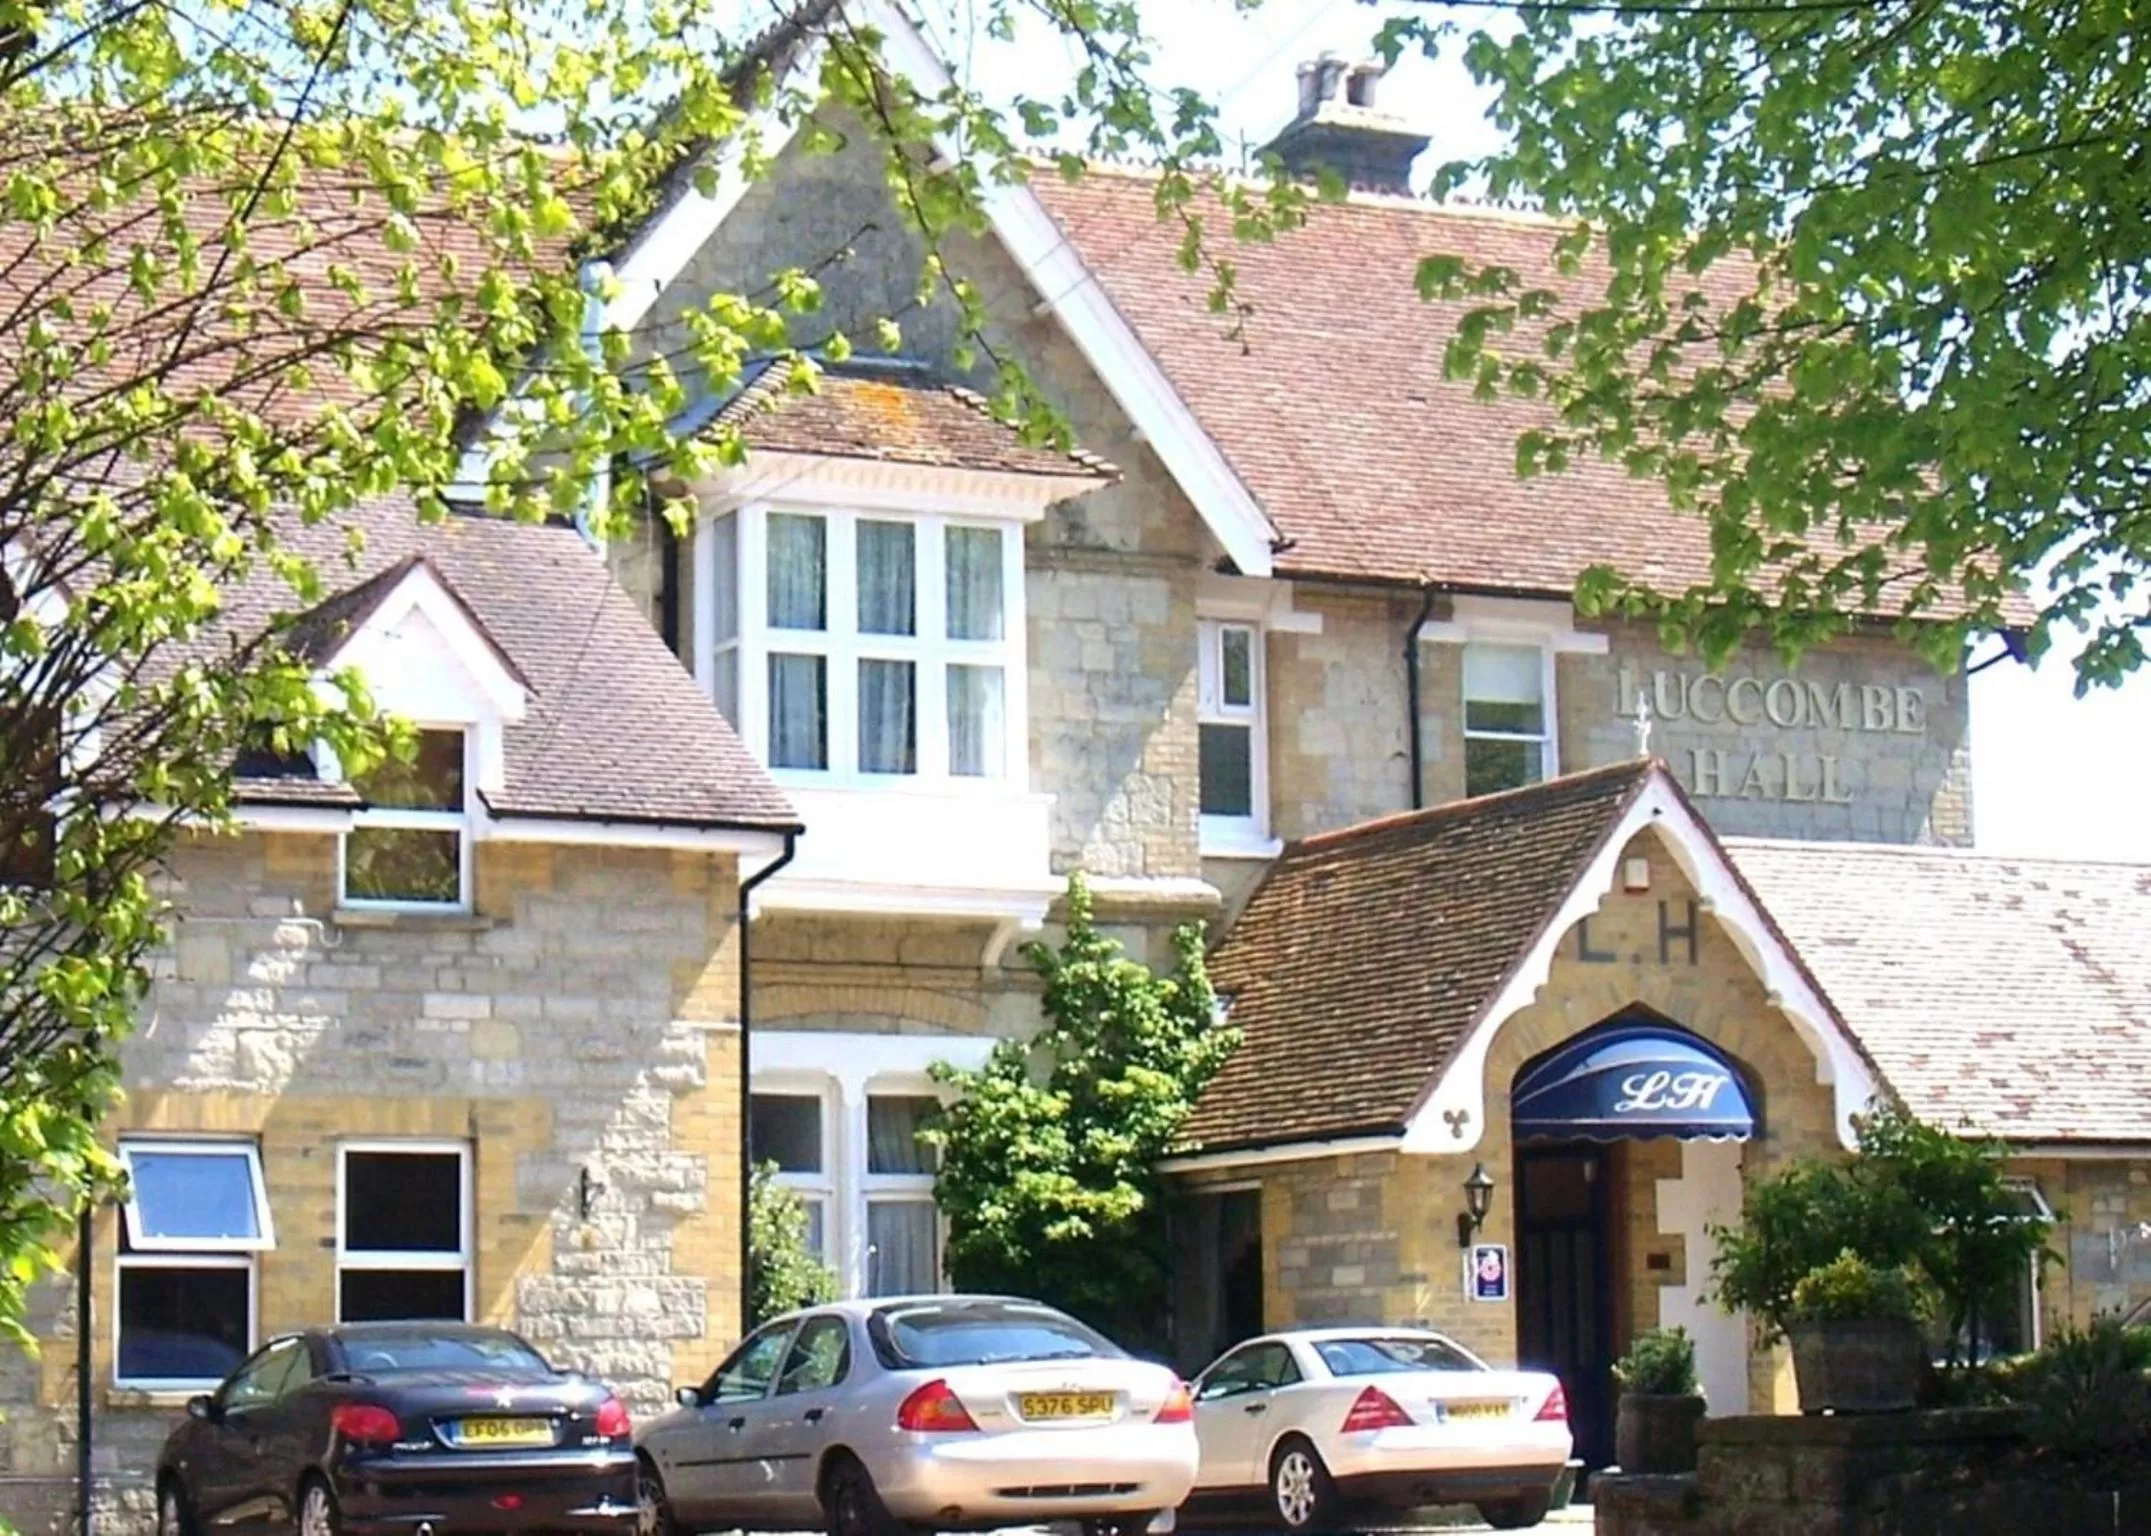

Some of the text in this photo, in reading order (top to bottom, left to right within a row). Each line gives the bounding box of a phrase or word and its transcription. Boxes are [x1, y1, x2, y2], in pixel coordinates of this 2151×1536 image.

[1614, 666, 1926, 733] LUCCOMBE
[1689, 749, 1854, 803] HALL
[1614, 1071, 1728, 1112] LH
[1023, 1397, 1073, 1417] S376
